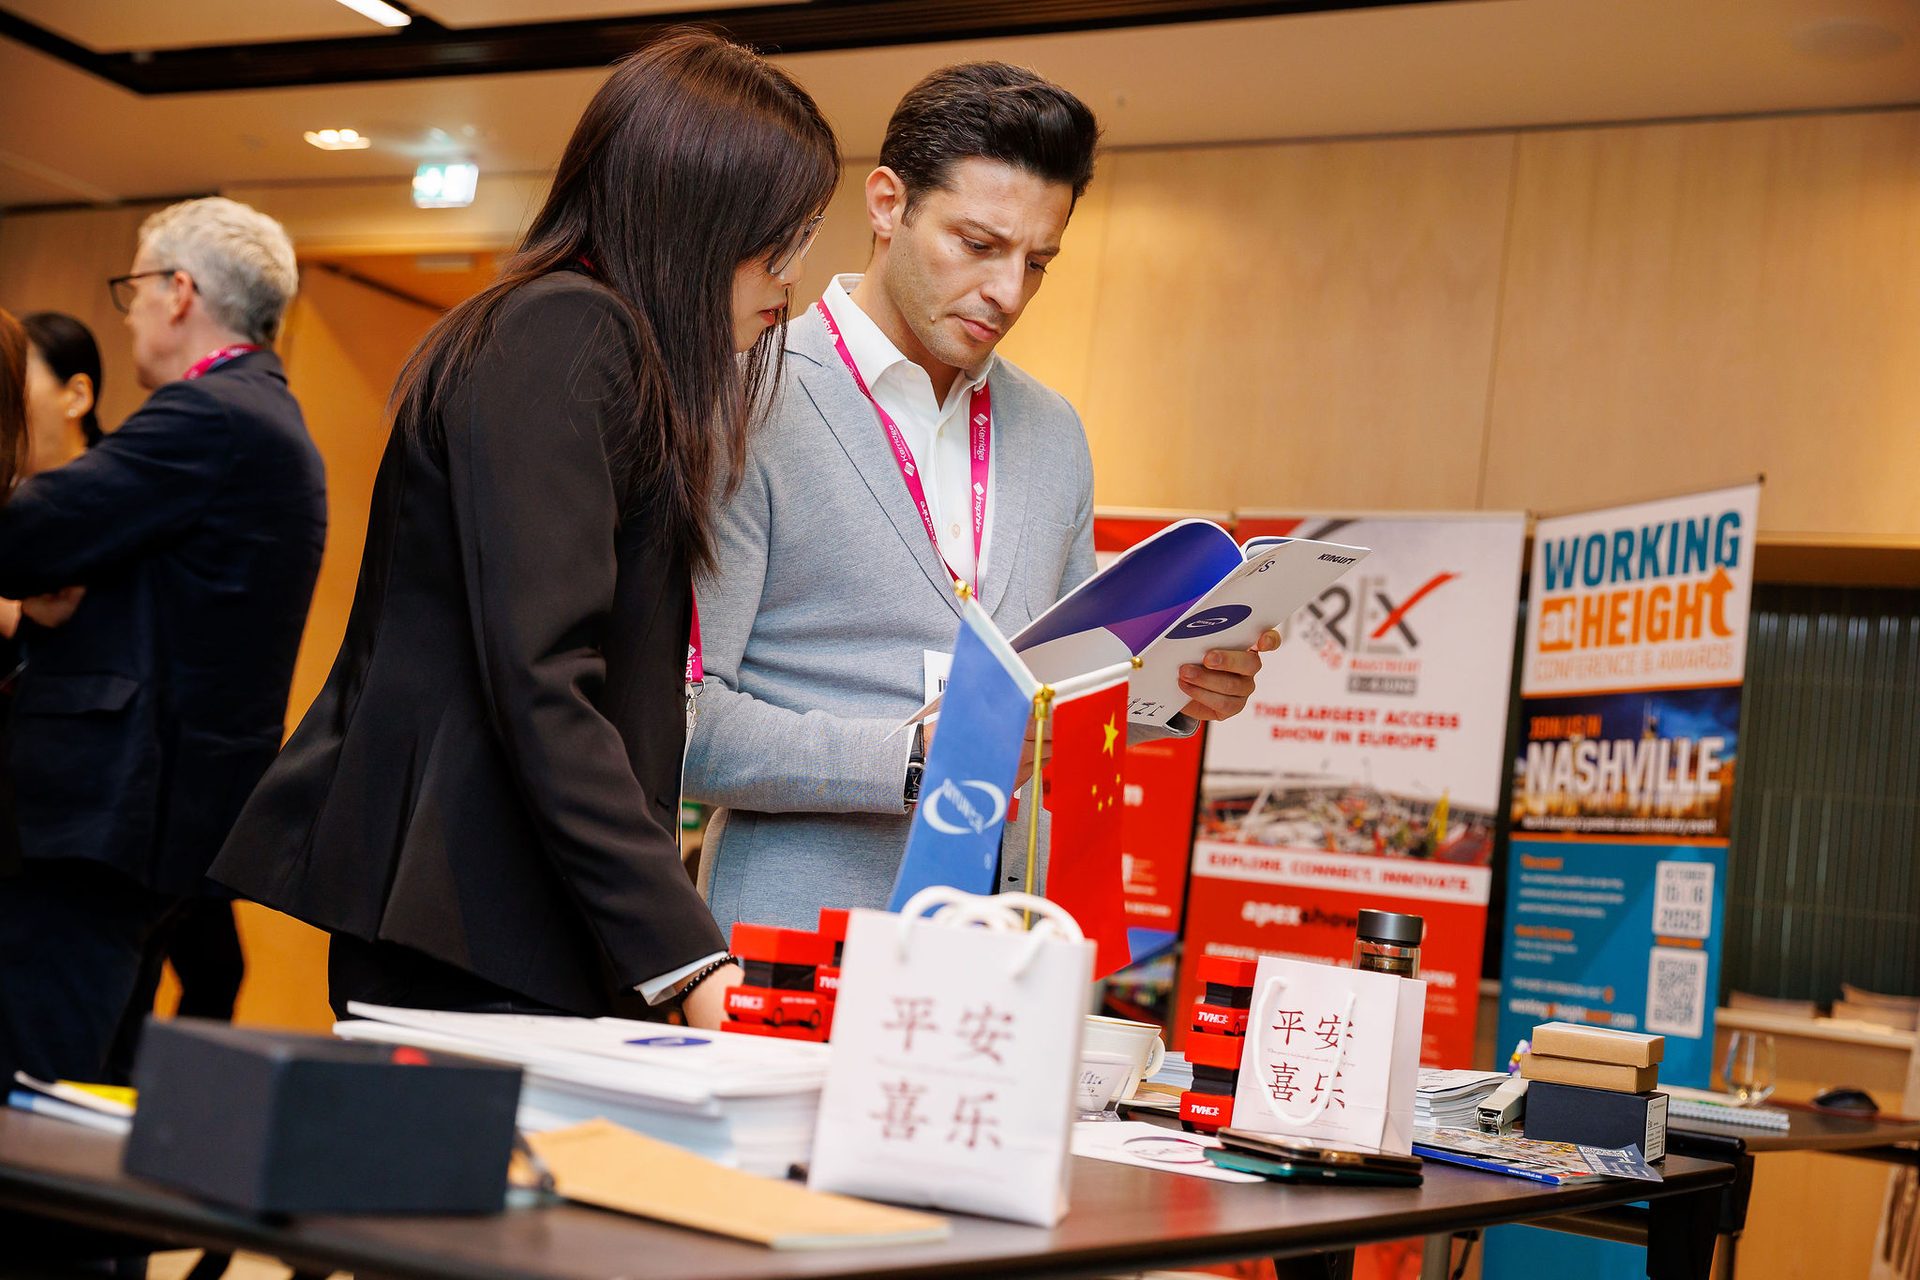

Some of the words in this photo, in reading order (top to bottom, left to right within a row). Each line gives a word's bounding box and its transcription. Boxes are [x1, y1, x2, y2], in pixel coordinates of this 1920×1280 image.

[888, 424, 908, 462] Kerridge
[976, 426, 987, 461] Kerridge
[1544, 511, 1741, 591] WORKING
[1534, 651, 1637, 682] CONFERENCE
[1658, 644, 1734, 671] AWARDS
[1254, 703, 1290, 720] THE
[1295, 704, 1378, 725] LARGEST
[1384, 708, 1461, 730] ACCESS
[1271, 726, 1324, 744] SHOW
[1332, 728, 1352, 744] IN
[1358, 730, 1437, 750] EUROPE
[1526, 737, 1725, 797] NASHVILLE
[881, 994, 1016, 1066] 平安
[1272, 1010, 1353, 1055] 平安
[1268, 1061, 1346, 1109] 喜乐
[867, 1077, 1002, 1149] 喜乐
